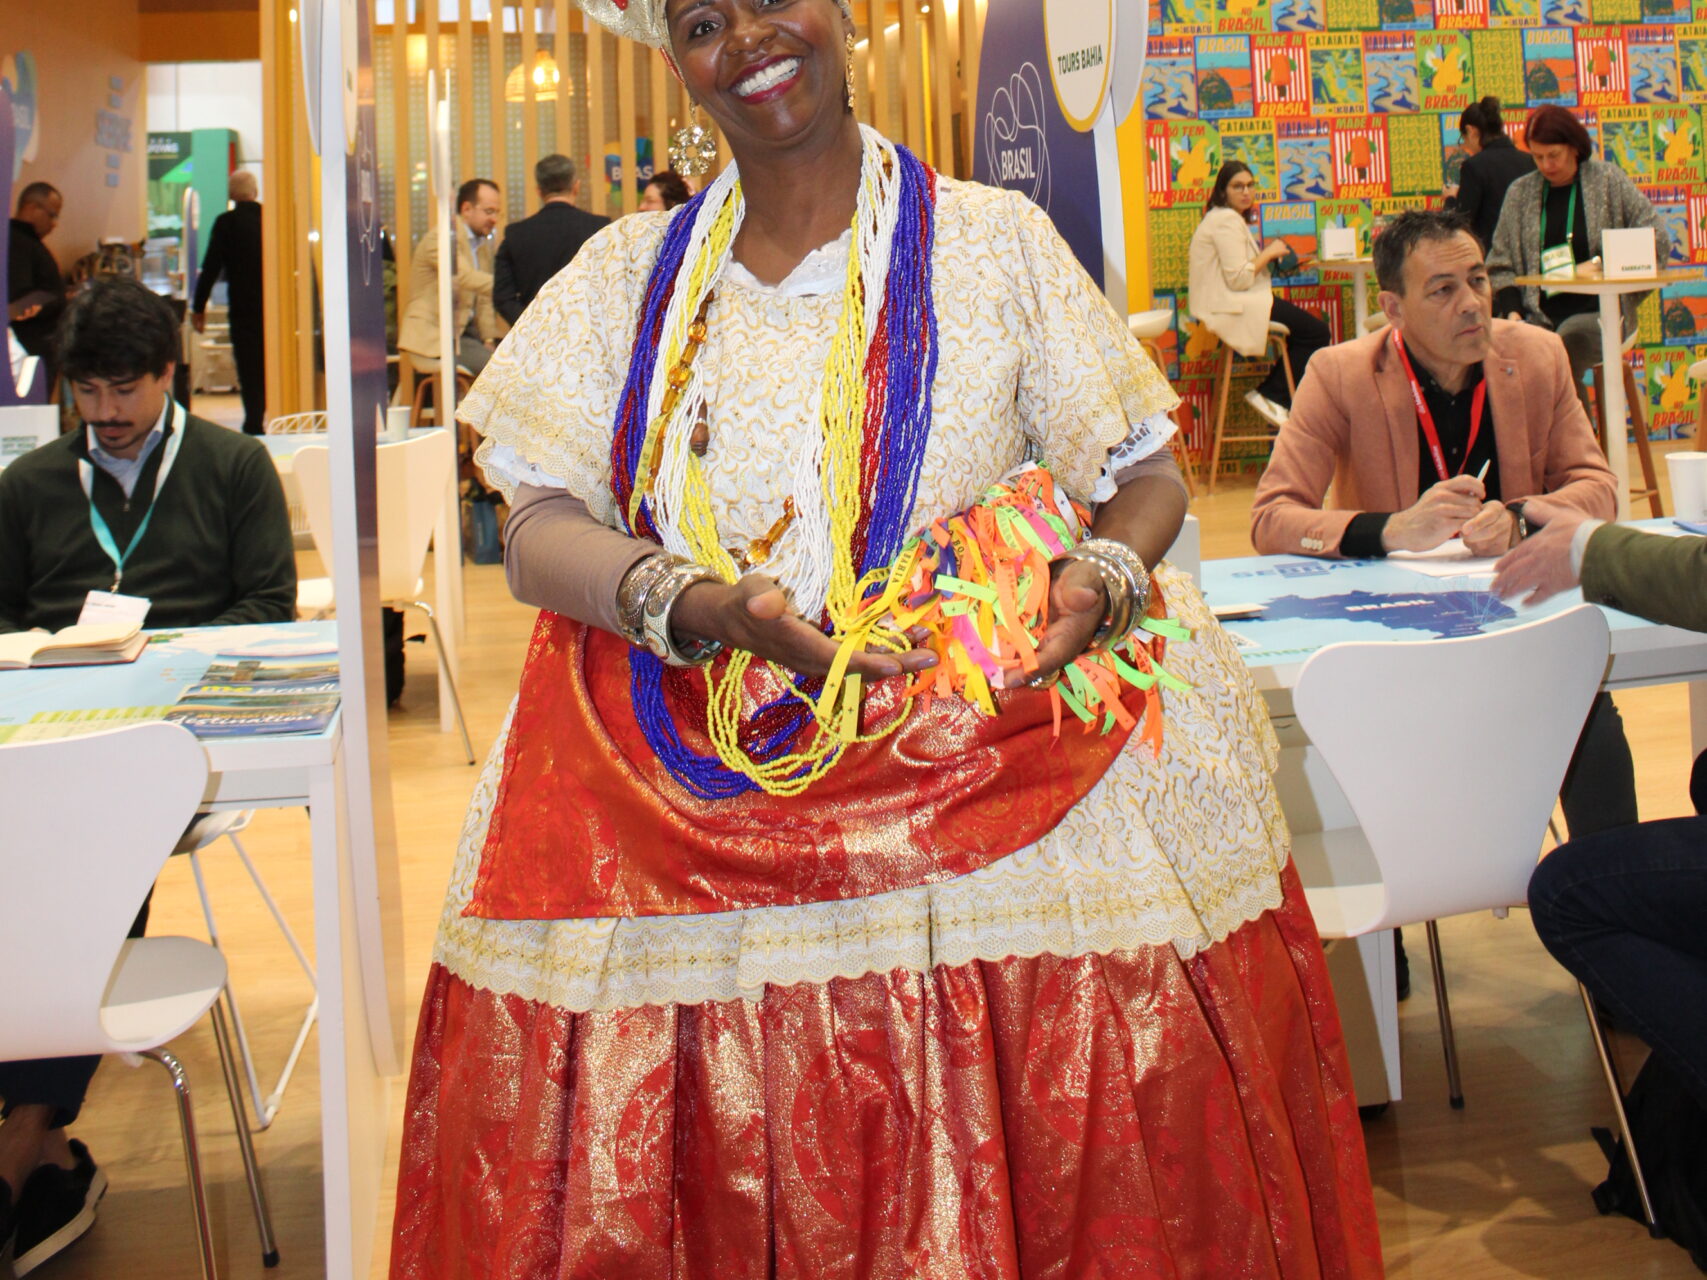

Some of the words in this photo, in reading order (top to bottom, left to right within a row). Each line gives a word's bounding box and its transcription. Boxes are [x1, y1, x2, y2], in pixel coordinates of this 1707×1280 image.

[1440, 15, 1484, 29] BRASIL
[1057, 51, 1080, 76] TOURS
[1081, 44, 1103, 70] BAHIA
[1583, 91, 1627, 106] BRASIL
[1260, 102, 1307, 117] BRASIL
[1001, 147, 1036, 181] BRASIL
[1340, 185, 1387, 198] BRASIL
